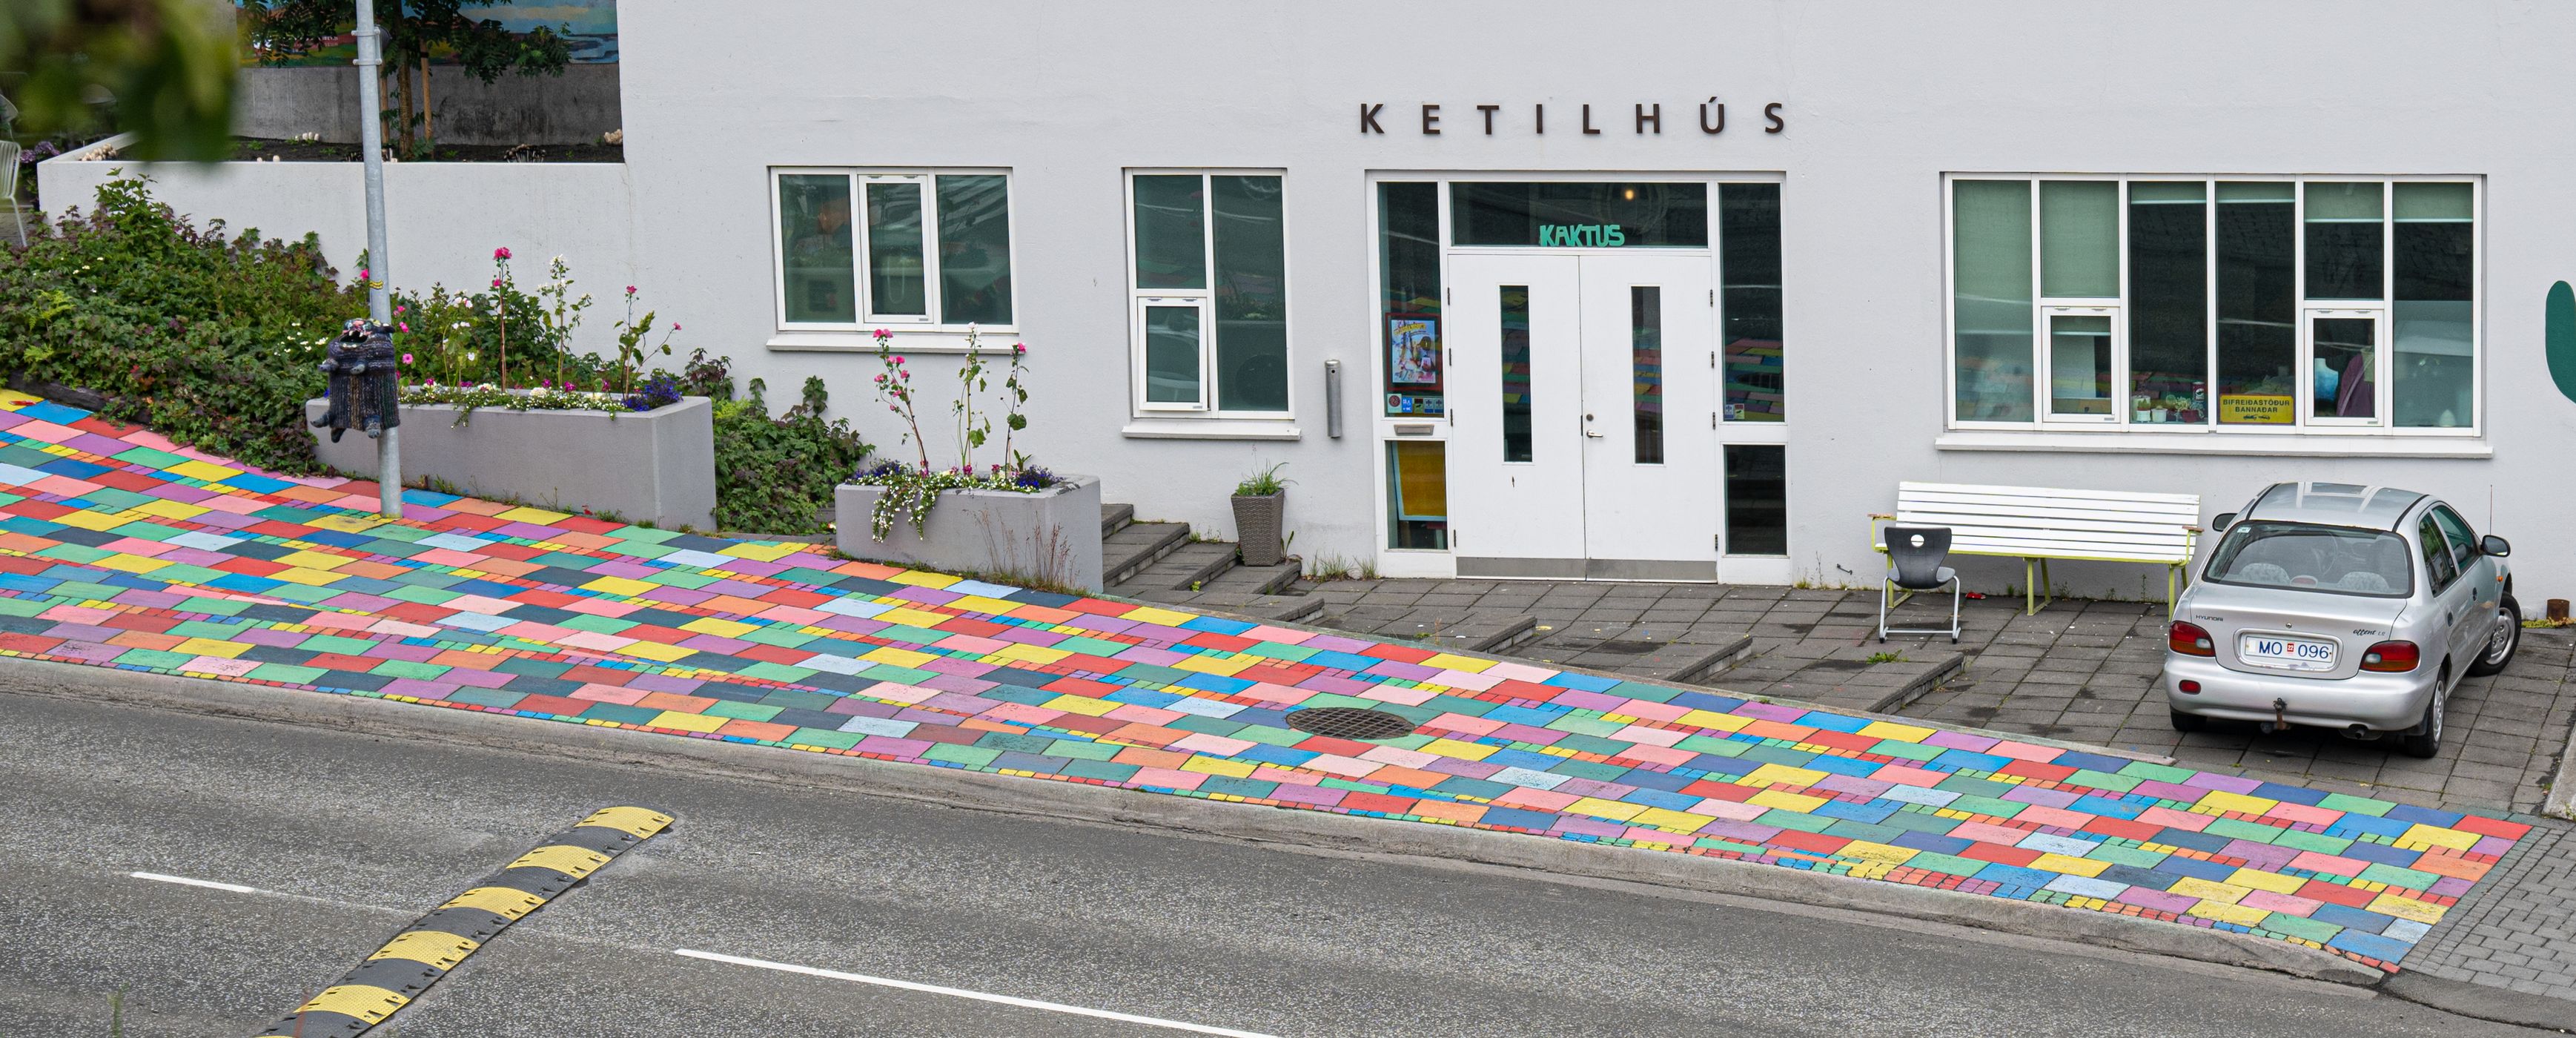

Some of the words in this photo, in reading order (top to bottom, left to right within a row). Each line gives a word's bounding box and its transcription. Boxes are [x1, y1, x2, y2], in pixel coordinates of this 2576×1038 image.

[1360, 97, 1785, 134] KETILHÚS
[1539, 224, 1625, 247] KAKTUS
[2259, 641, 2282, 655] MO
[2298, 644, 2329, 659] 096
